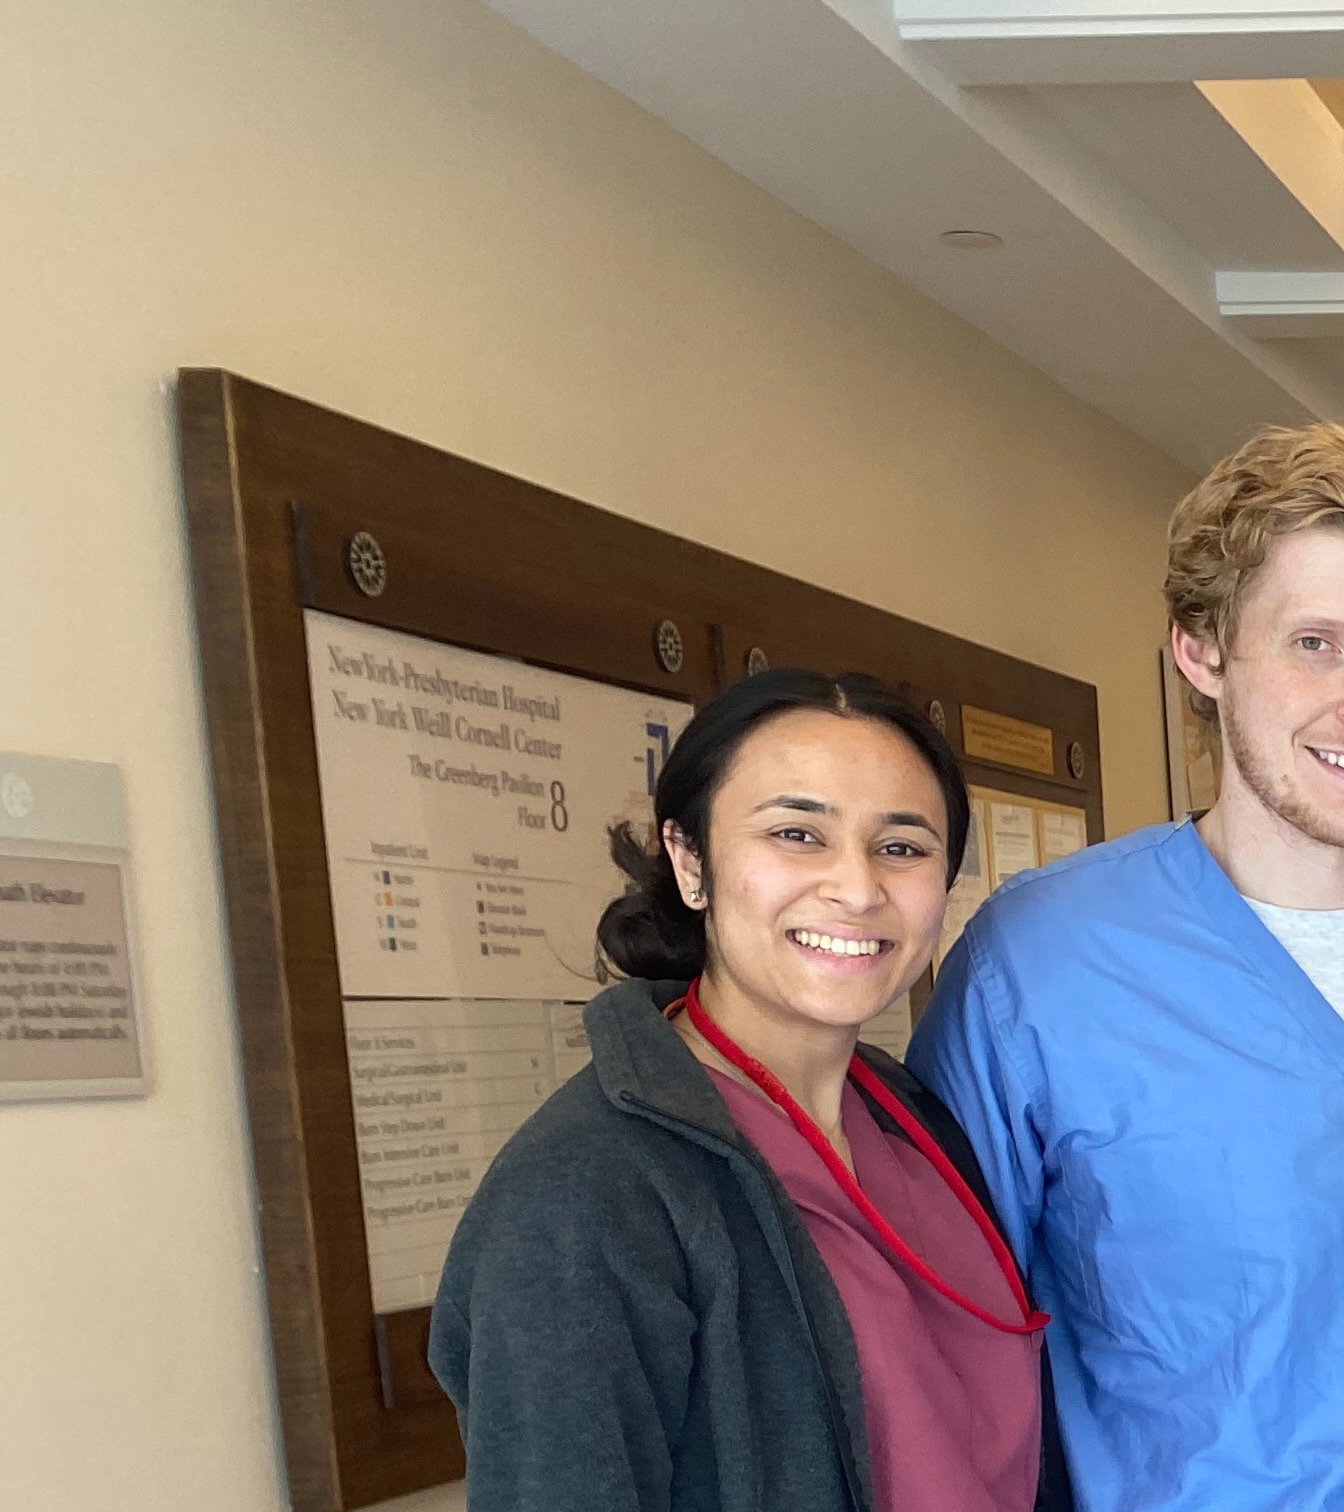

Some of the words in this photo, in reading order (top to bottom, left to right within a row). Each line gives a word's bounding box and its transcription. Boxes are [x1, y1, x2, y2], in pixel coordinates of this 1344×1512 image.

[331, 689, 369, 721] New
[371, 697, 409, 730] York
[411, 706, 451, 739] Weill
[454, 715, 511, 750] Cornell
[514, 728, 562, 760] Center
[502, 685, 561, 723] Hospital
[407, 754, 432, 780] The
[435, 759, 500, 798] Greenberg
[502, 770, 545, 796] Pavilion
[517, 806, 546, 829] Floor
[551, 780, 568, 832] 8
